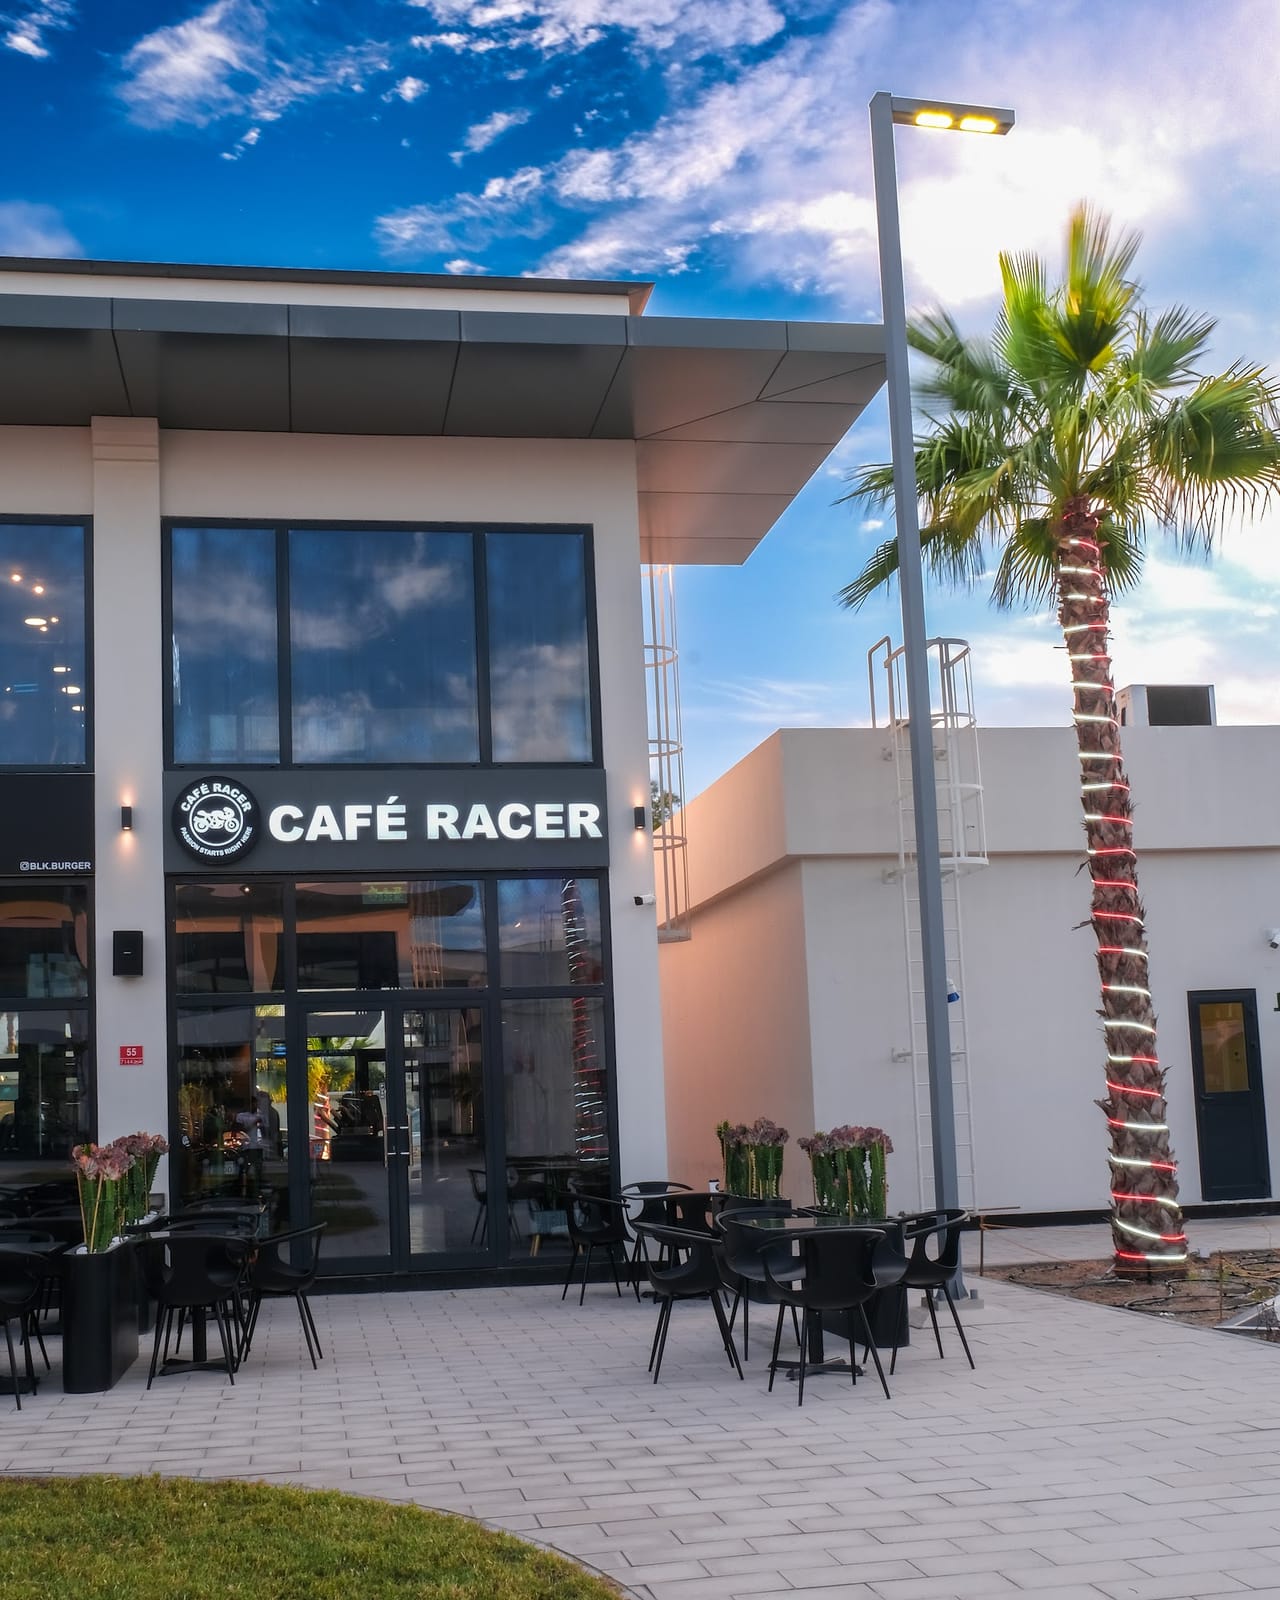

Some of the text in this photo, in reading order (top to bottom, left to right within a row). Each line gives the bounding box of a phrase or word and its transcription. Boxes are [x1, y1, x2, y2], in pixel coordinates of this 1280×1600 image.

[180, 783, 252, 812] CAFÉ RACER
[268, 795, 603, 842] CAFÉ RACER
[180, 826, 253, 857] PASSION STARTS RIGHT HERE
[126, 1048, 136, 1056] 55
